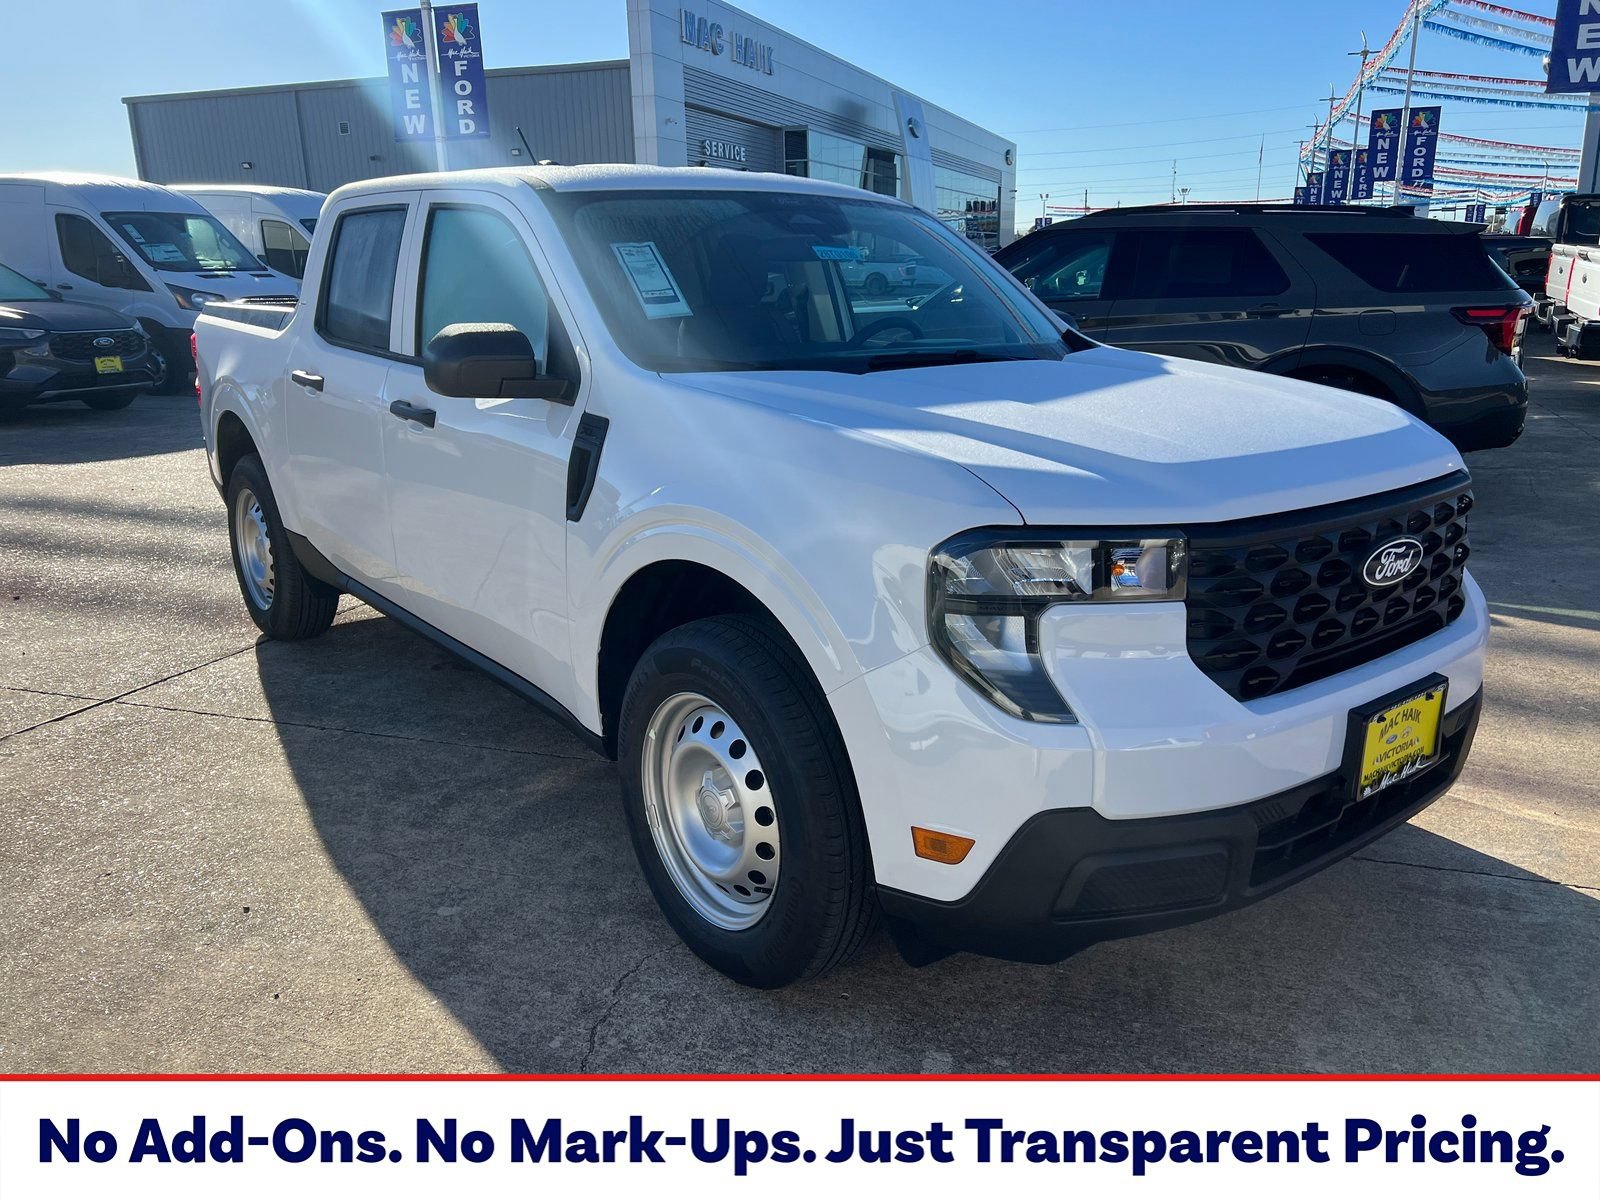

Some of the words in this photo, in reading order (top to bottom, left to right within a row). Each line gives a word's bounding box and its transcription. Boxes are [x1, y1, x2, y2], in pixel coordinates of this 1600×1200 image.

[680, 8, 724, 56] MAC
[730, 31, 774, 76] HAIK
[401, 62, 425, 135] NEW
[454, 60, 475, 134] FORD
[704, 140, 747, 162] SERVICE
[1373, 138, 1390, 178] NEW
[1412, 136, 1427, 178] FORD
[1309, 187, 1318, 205] NE
[1331, 170, 1343, 199] NEW
[1375, 545, 1414, 580] Ford
[1378, 712, 1401, 741] MAC
[1401, 708, 1422, 724] HAIK
[1379, 741, 1415, 763] VICTORIA
[1379, 771, 1398, 790] Mac
